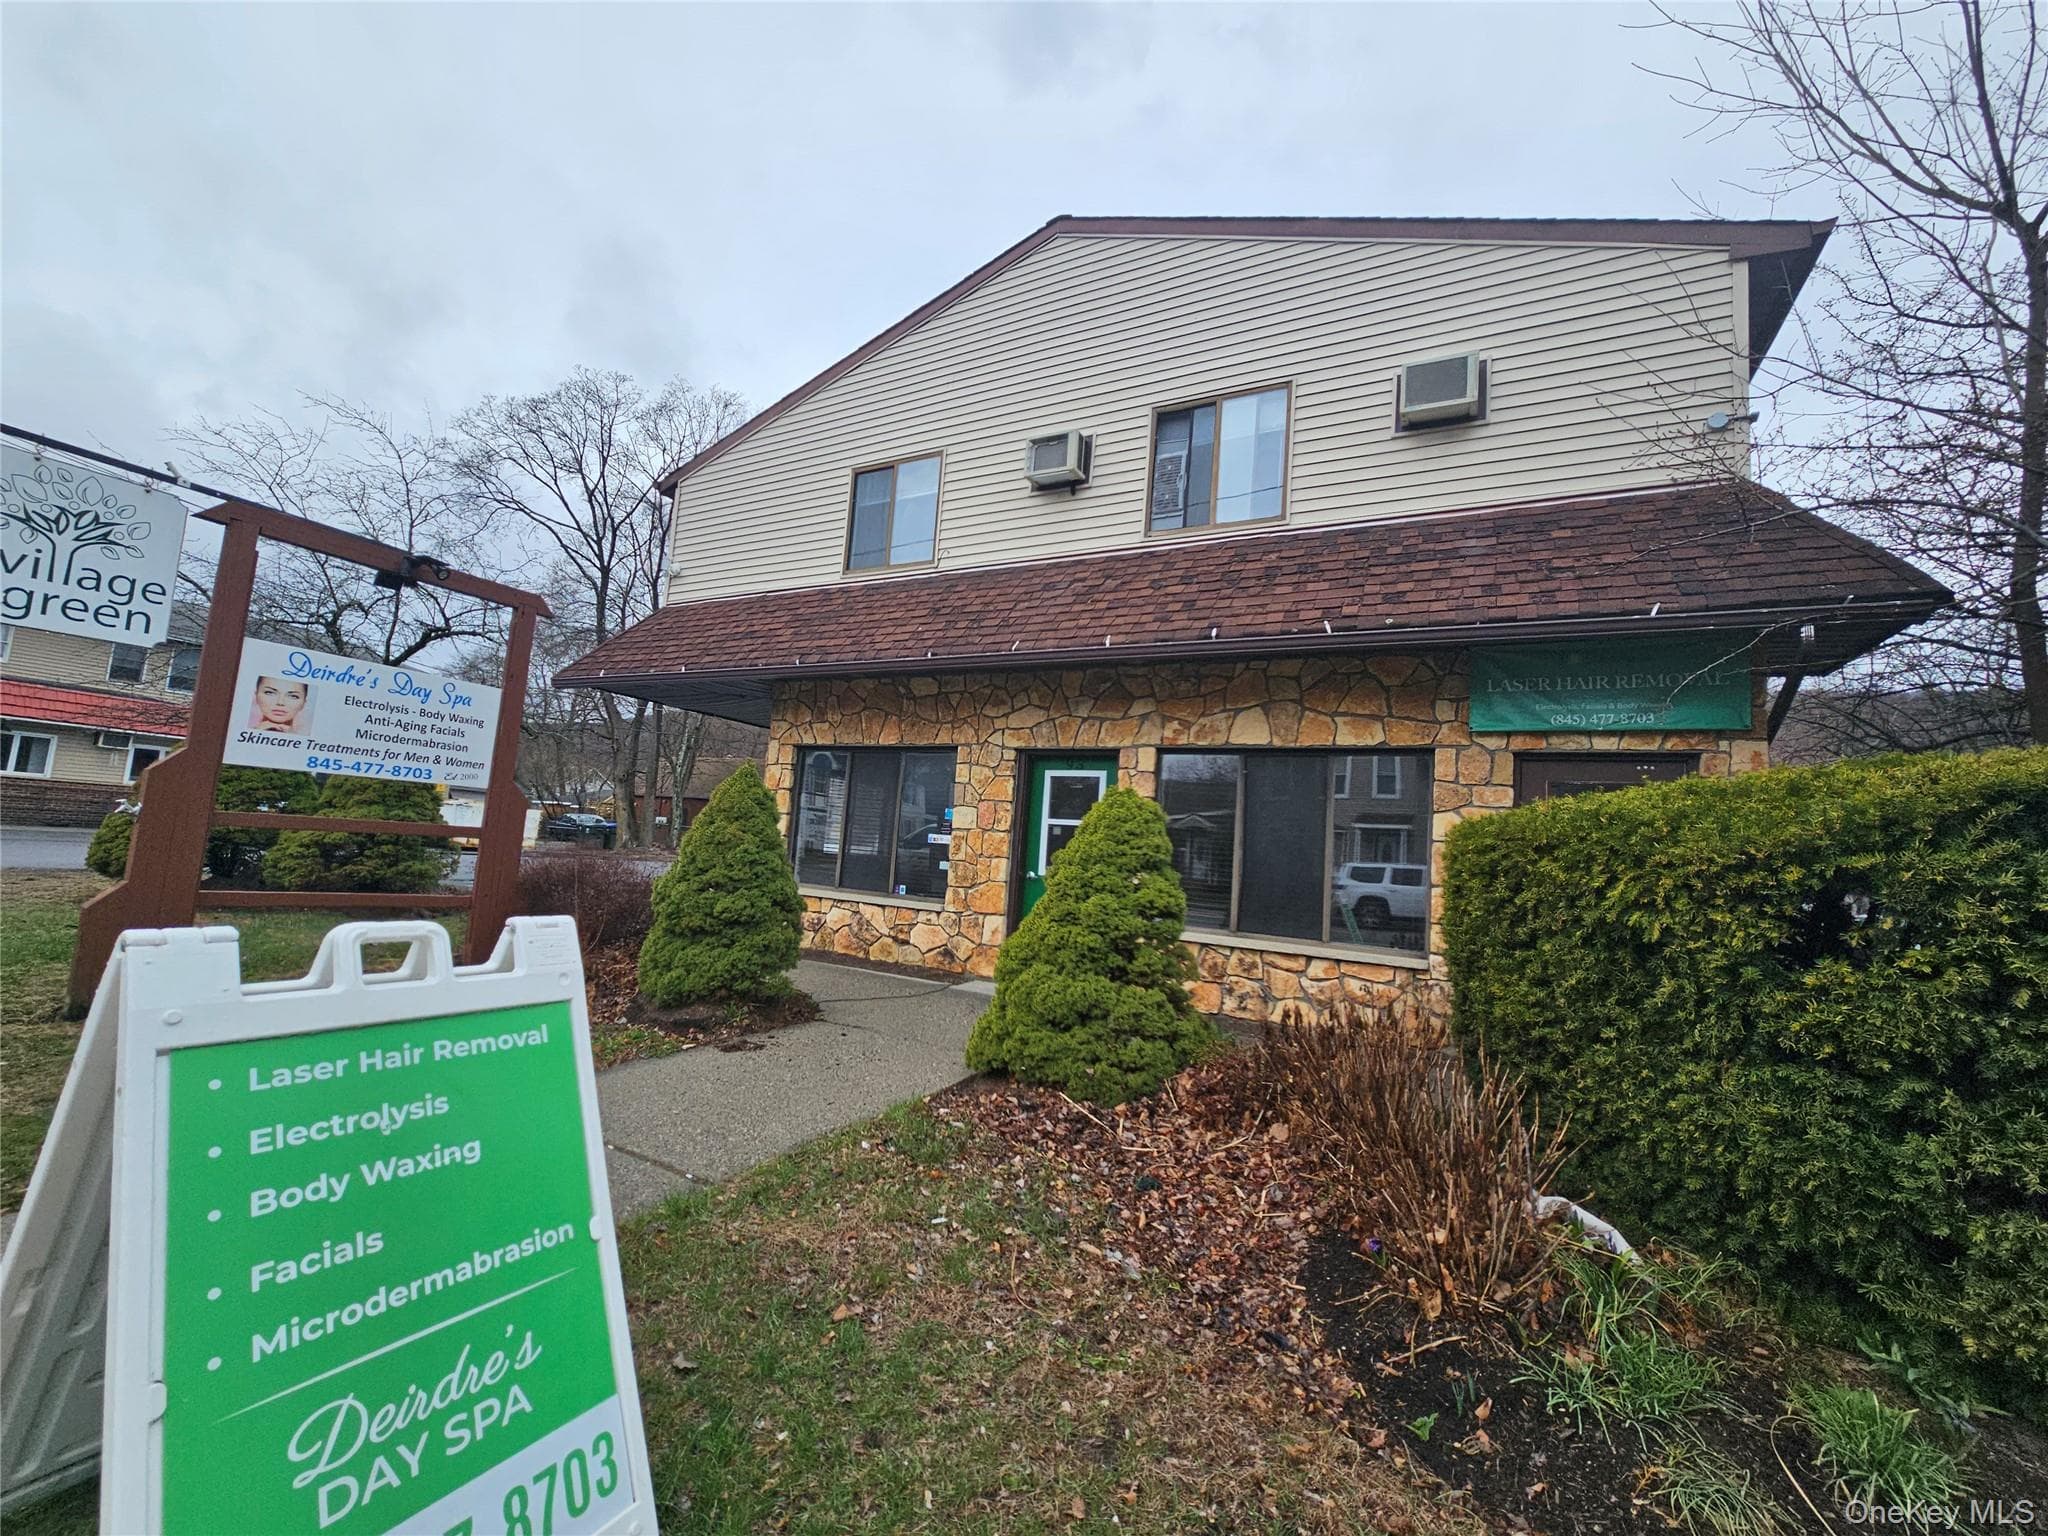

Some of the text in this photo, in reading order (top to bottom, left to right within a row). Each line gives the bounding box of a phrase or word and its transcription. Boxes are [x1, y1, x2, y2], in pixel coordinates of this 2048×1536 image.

[1, 586, 152, 634] green
[281, 651, 473, 709] Deirdre's Day Spa
[1487, 676, 1552, 693] LASER
[1556, 674, 1611, 691] HAIR
[344, 695, 409, 715] Electrolysis
[419, 708, 446, 723] Body
[448, 712, 485, 729] Waxing
[364, 714, 465, 738] Anti-Aging Facials
[1551, 712, 1655, 726] (845) 477-8703
[237, 731, 485, 770] Skincare Treatments for Men & Women
[355, 728, 469, 753] Microdermabrasion
[306, 756, 433, 780] 845-477-8703
[248, 1023, 549, 1092] Laser Hair Removal
[249, 1093, 450, 1156] Electrolysis
[250, 1139, 482, 1218] Body Waxing
[250, 1229, 384, 1294] Facials
[251, 1221, 575, 1363] Microdermabrasion
[287, 1324, 542, 1490] Deirdre's
[317, 1385, 534, 1530] DAY SPA
